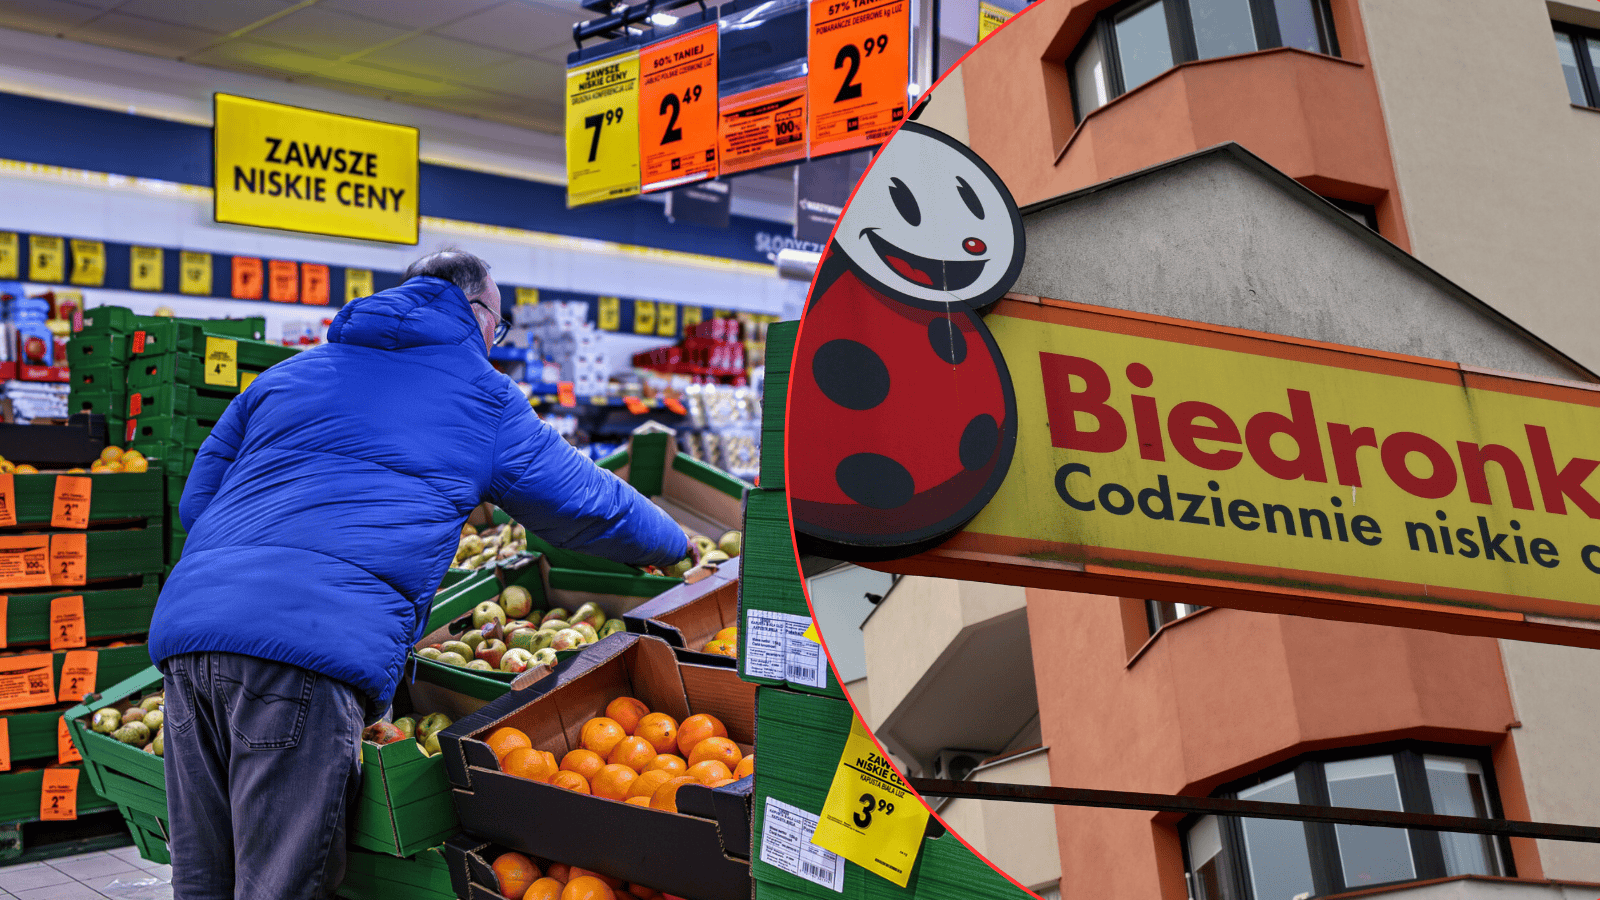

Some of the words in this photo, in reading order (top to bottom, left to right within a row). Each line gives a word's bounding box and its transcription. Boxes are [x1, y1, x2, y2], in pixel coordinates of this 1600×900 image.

[828, 1, 850, 16] 57%
[891, 4, 903, 14] LUZ
[653, 55, 672, 69] 50%
[673, 43, 704, 62] TANIEJ
[578, 75, 605, 92] NISKIE
[605, 70, 628, 85] CENY
[586, 63, 620, 81] ZAWSZE
[264, 135, 378, 179] ZAWSZE
[233, 164, 327, 204] NISKIE
[336, 180, 406, 213] CENY
[1038, 351, 1600, 520] Biedronk
[1053, 461, 1384, 548] Codziennie
[1404, 508, 1561, 570] niskie
[855, 757, 889, 779] NISKIE
[867, 752, 896, 773] ZAW
[859, 774, 882, 788] KAPUSTA
[895, 788, 906, 799] LUZ
